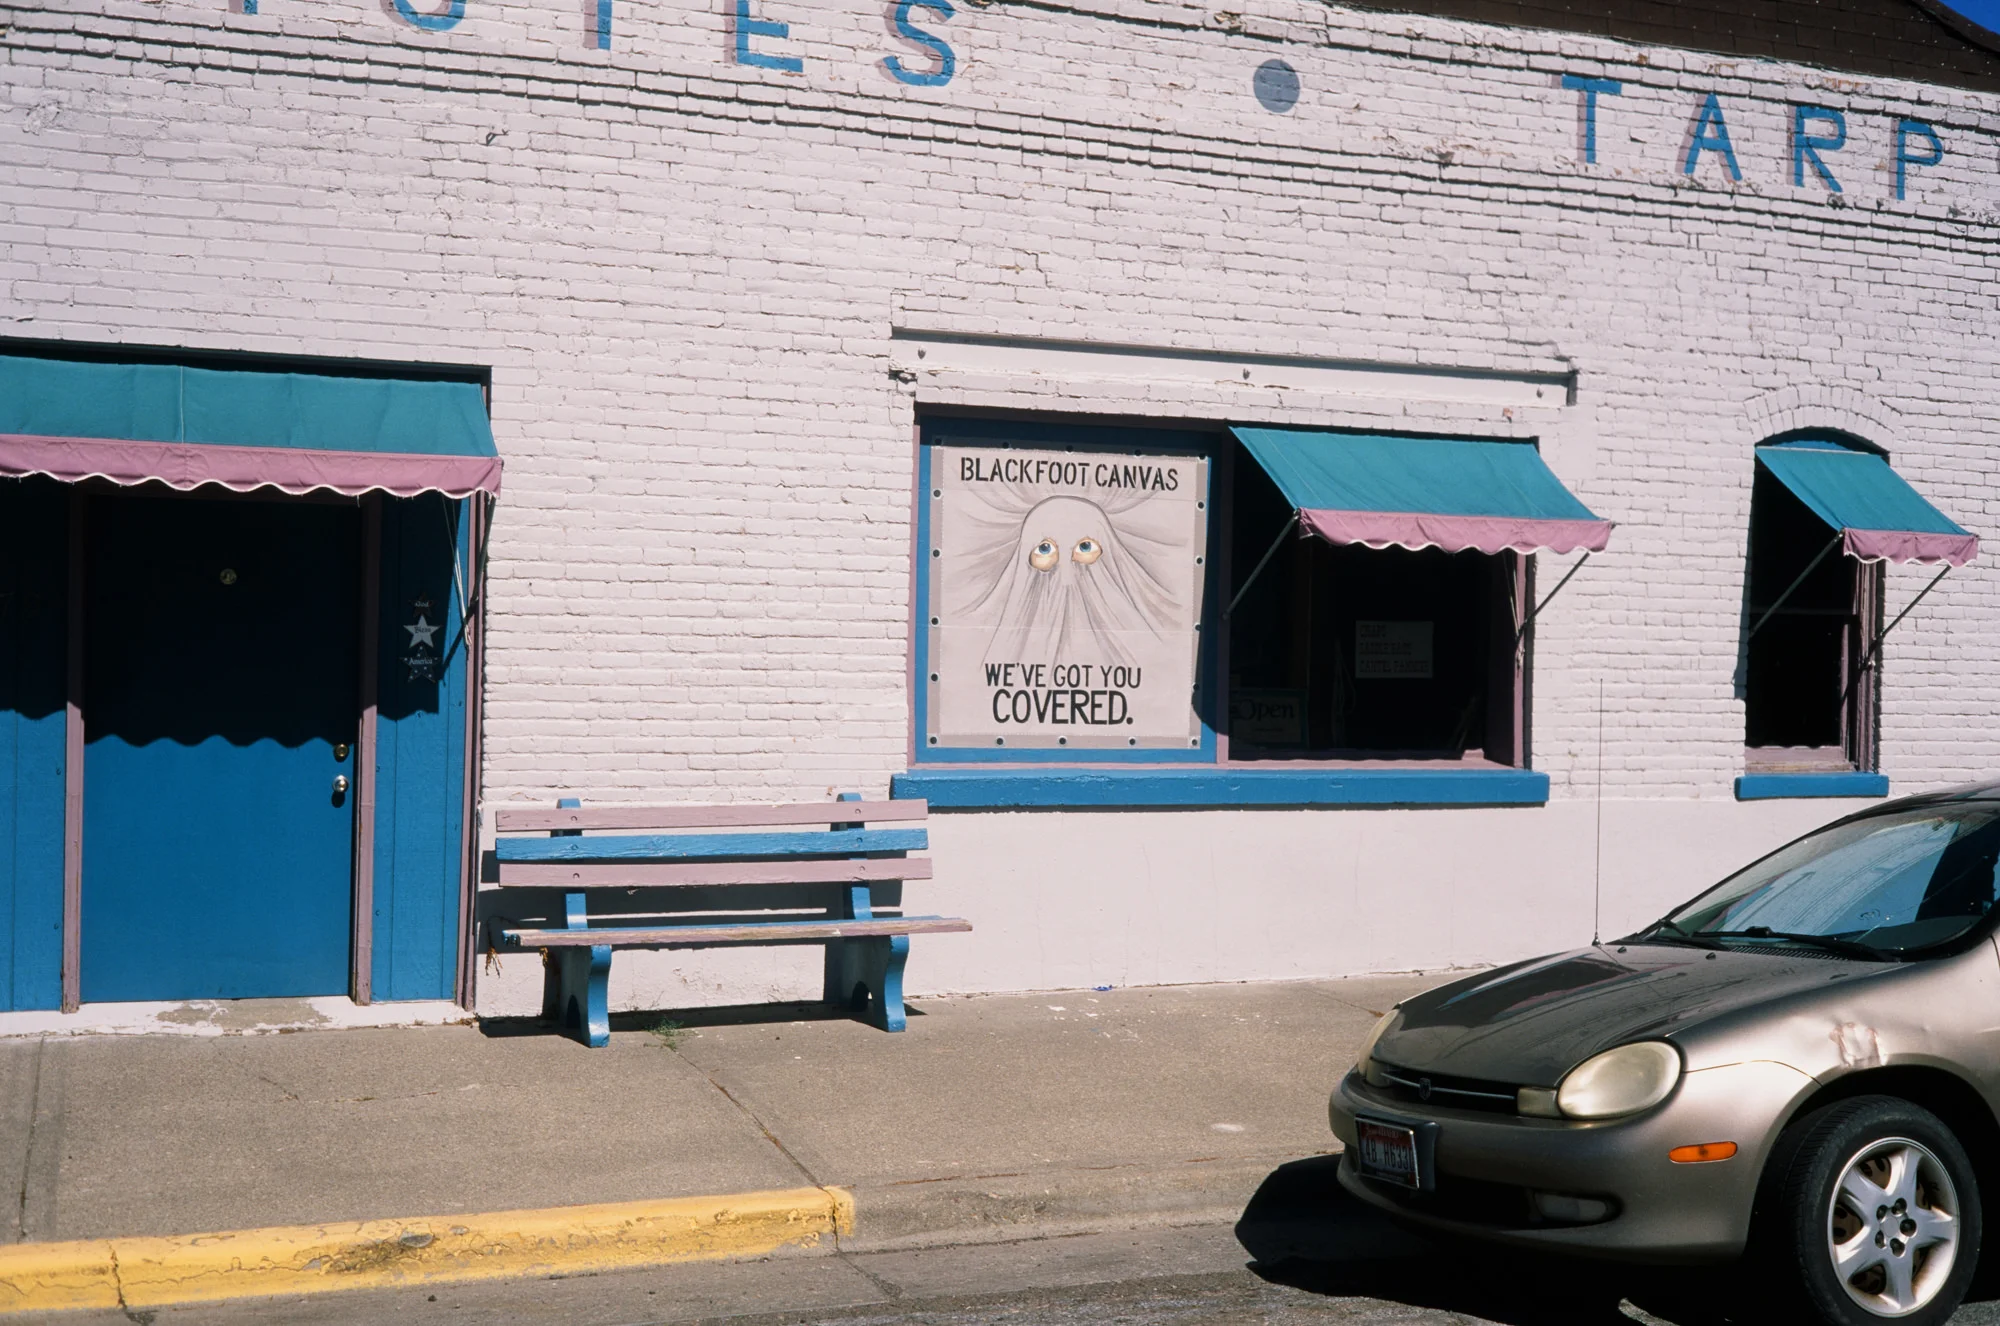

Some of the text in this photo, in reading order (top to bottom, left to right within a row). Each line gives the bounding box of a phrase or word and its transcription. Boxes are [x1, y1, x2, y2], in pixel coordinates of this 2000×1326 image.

[960, 457, 1179, 491] BLACKFOOT CANVAS
[985, 662, 1142, 689] WE'VE GOT YOU
[992, 689, 1134, 725] COVERED.
[1239, 699, 1295, 722] Open
